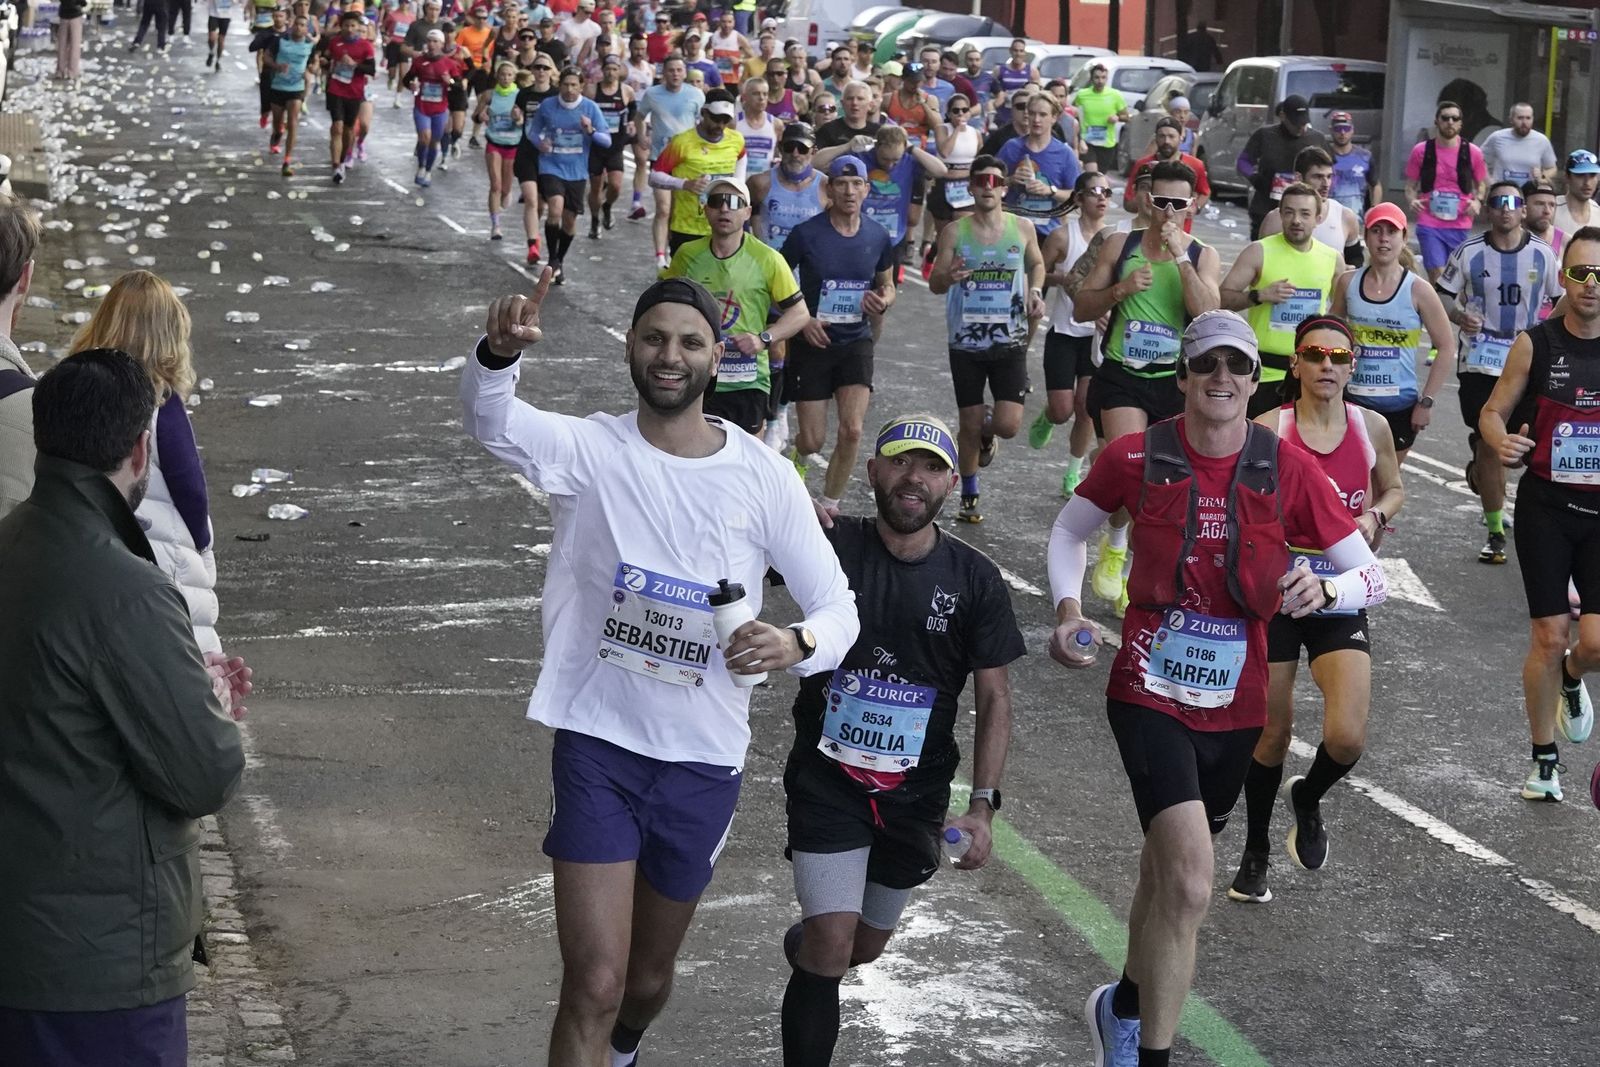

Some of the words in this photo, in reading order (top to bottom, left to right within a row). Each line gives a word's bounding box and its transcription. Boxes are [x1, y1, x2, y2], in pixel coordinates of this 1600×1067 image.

[1294, 290, 1317, 298] URICH
[1497, 282, 1521, 306] 10
[832, 303, 855, 313] FRED
[1376, 317, 1402, 326] CURVA
[1144, 324, 1173, 337] ZURICH
[1363, 349, 1394, 357] ZURICH
[1479, 355, 1503, 368] FIDEL
[1352, 374, 1395, 385] MARIBEL
[904, 423, 941, 444] OTSO
[1578, 444, 1599, 454] 9617
[1558, 456, 1600, 470] ALBER
[1567, 503, 1599, 515] SALOMON
[1196, 521, 1229, 540] AGA
[644, 608, 684, 631] 13013
[926, 615, 949, 632] OTSO
[1189, 619, 1238, 636] ZURICH
[603, 617, 711, 665] SEBASTIEN
[872, 646, 898, 666] The
[1186, 646, 1217, 661] 6186
[1163, 658, 1230, 686] FARFAN
[862, 711, 893, 728] 8534
[838, 722, 905, 752] SOULIA
